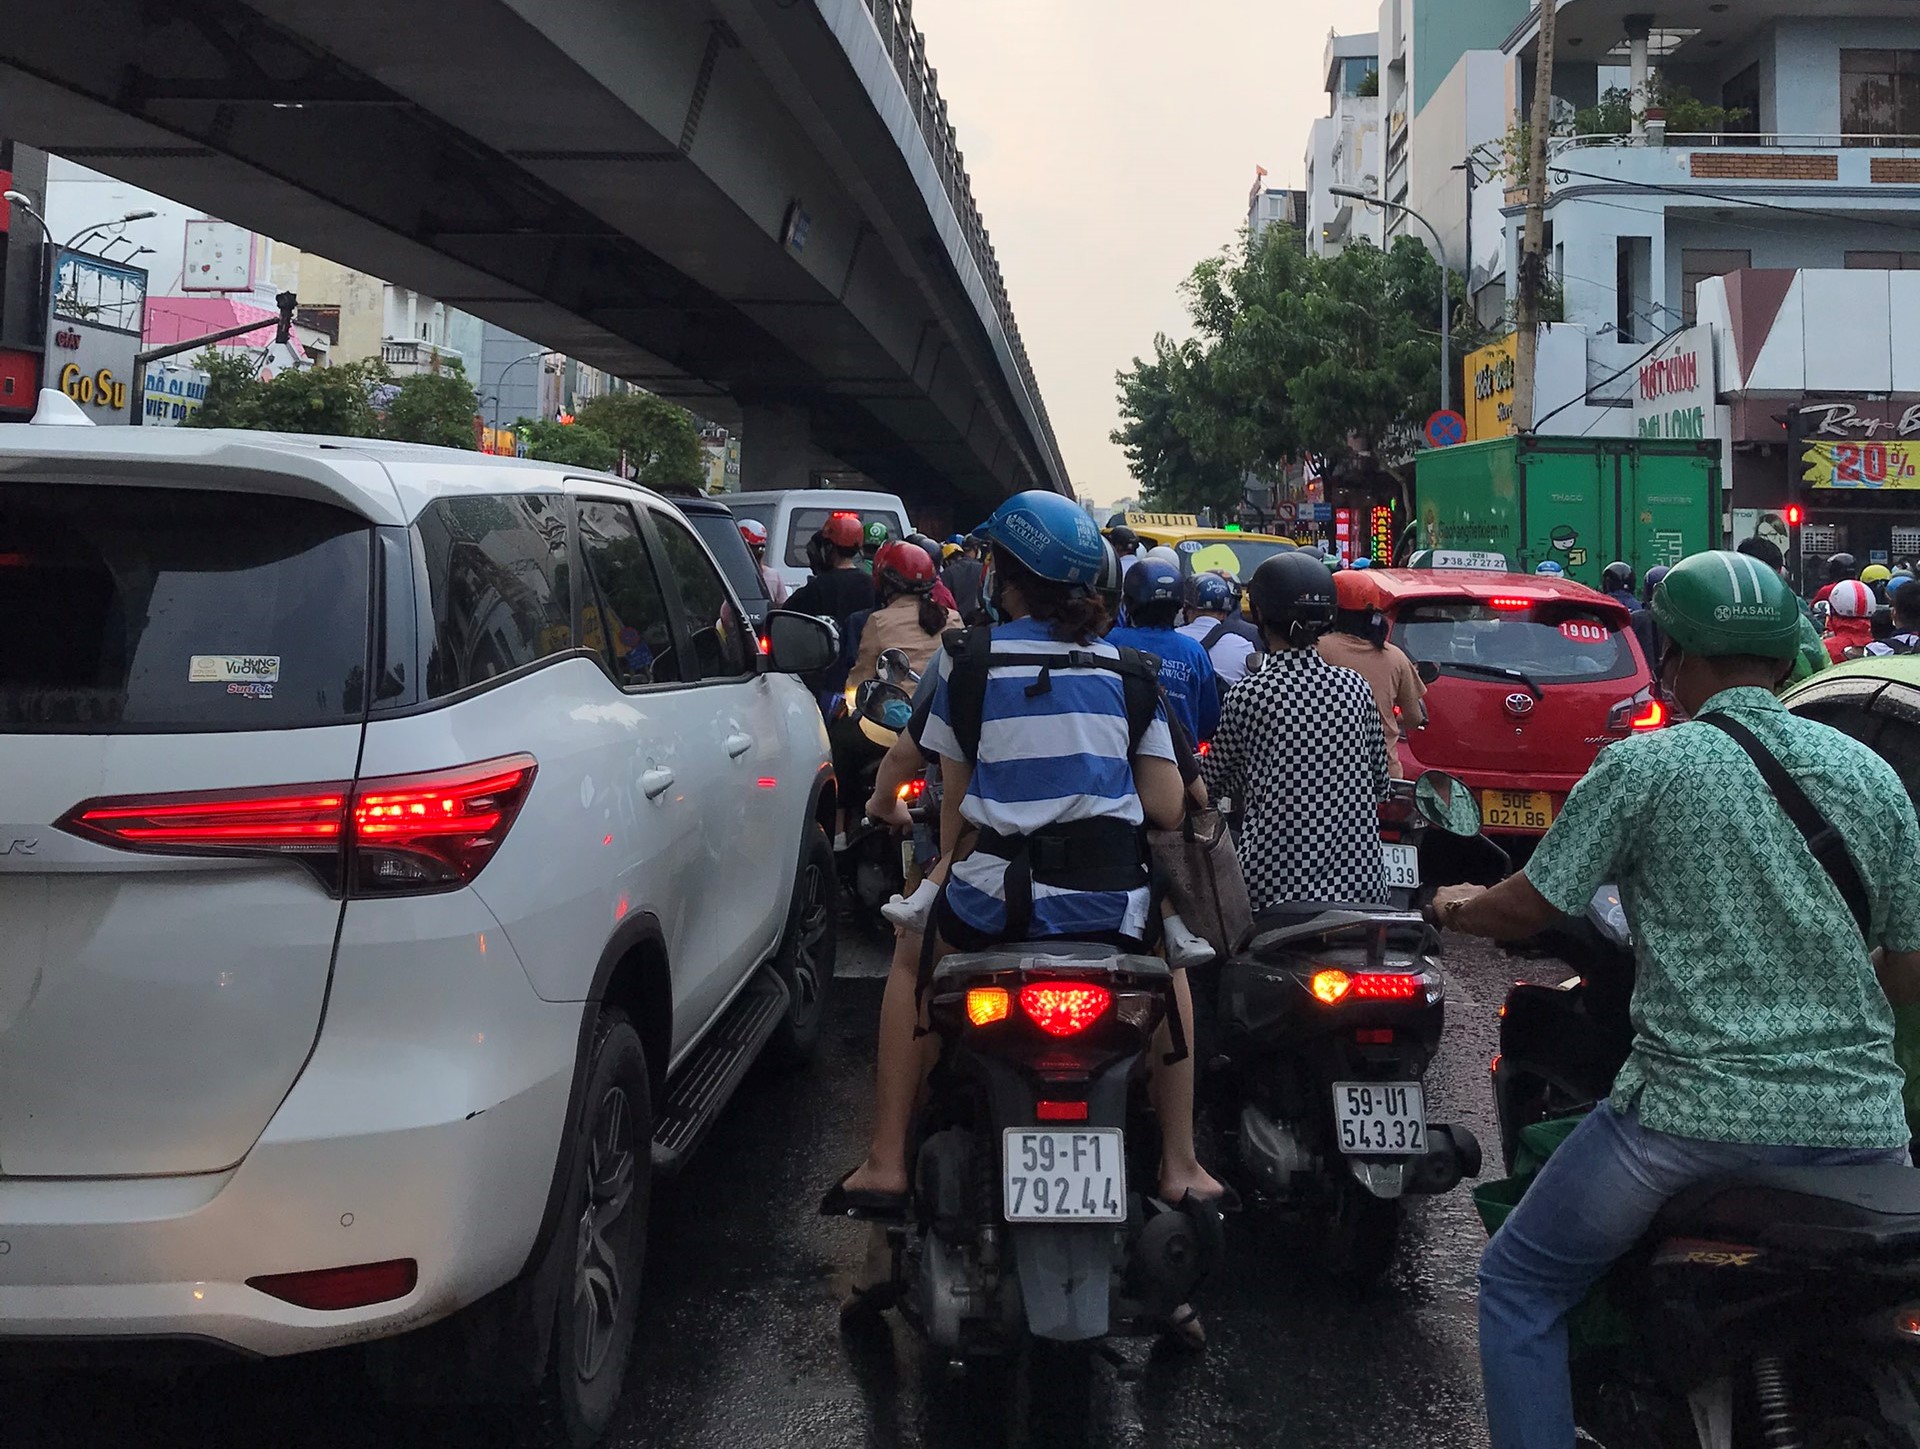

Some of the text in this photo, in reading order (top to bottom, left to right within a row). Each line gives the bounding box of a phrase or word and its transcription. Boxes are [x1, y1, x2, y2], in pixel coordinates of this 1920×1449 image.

[1130, 513, 1147, 524] 38
[1173, 515, 1192, 526] 111
[1733, 606, 1775, 616] HASAKI
[1502, 793, 1532, 809] 50E
[1490, 809, 1546, 827] 021.86
[1347, 1088, 1408, 1116] 59-U1
[1342, 1120, 1422, 1148] 543.32
[1022, 1135, 1101, 1172] 59-F1
[1012, 1177, 1118, 1215] 792.44
